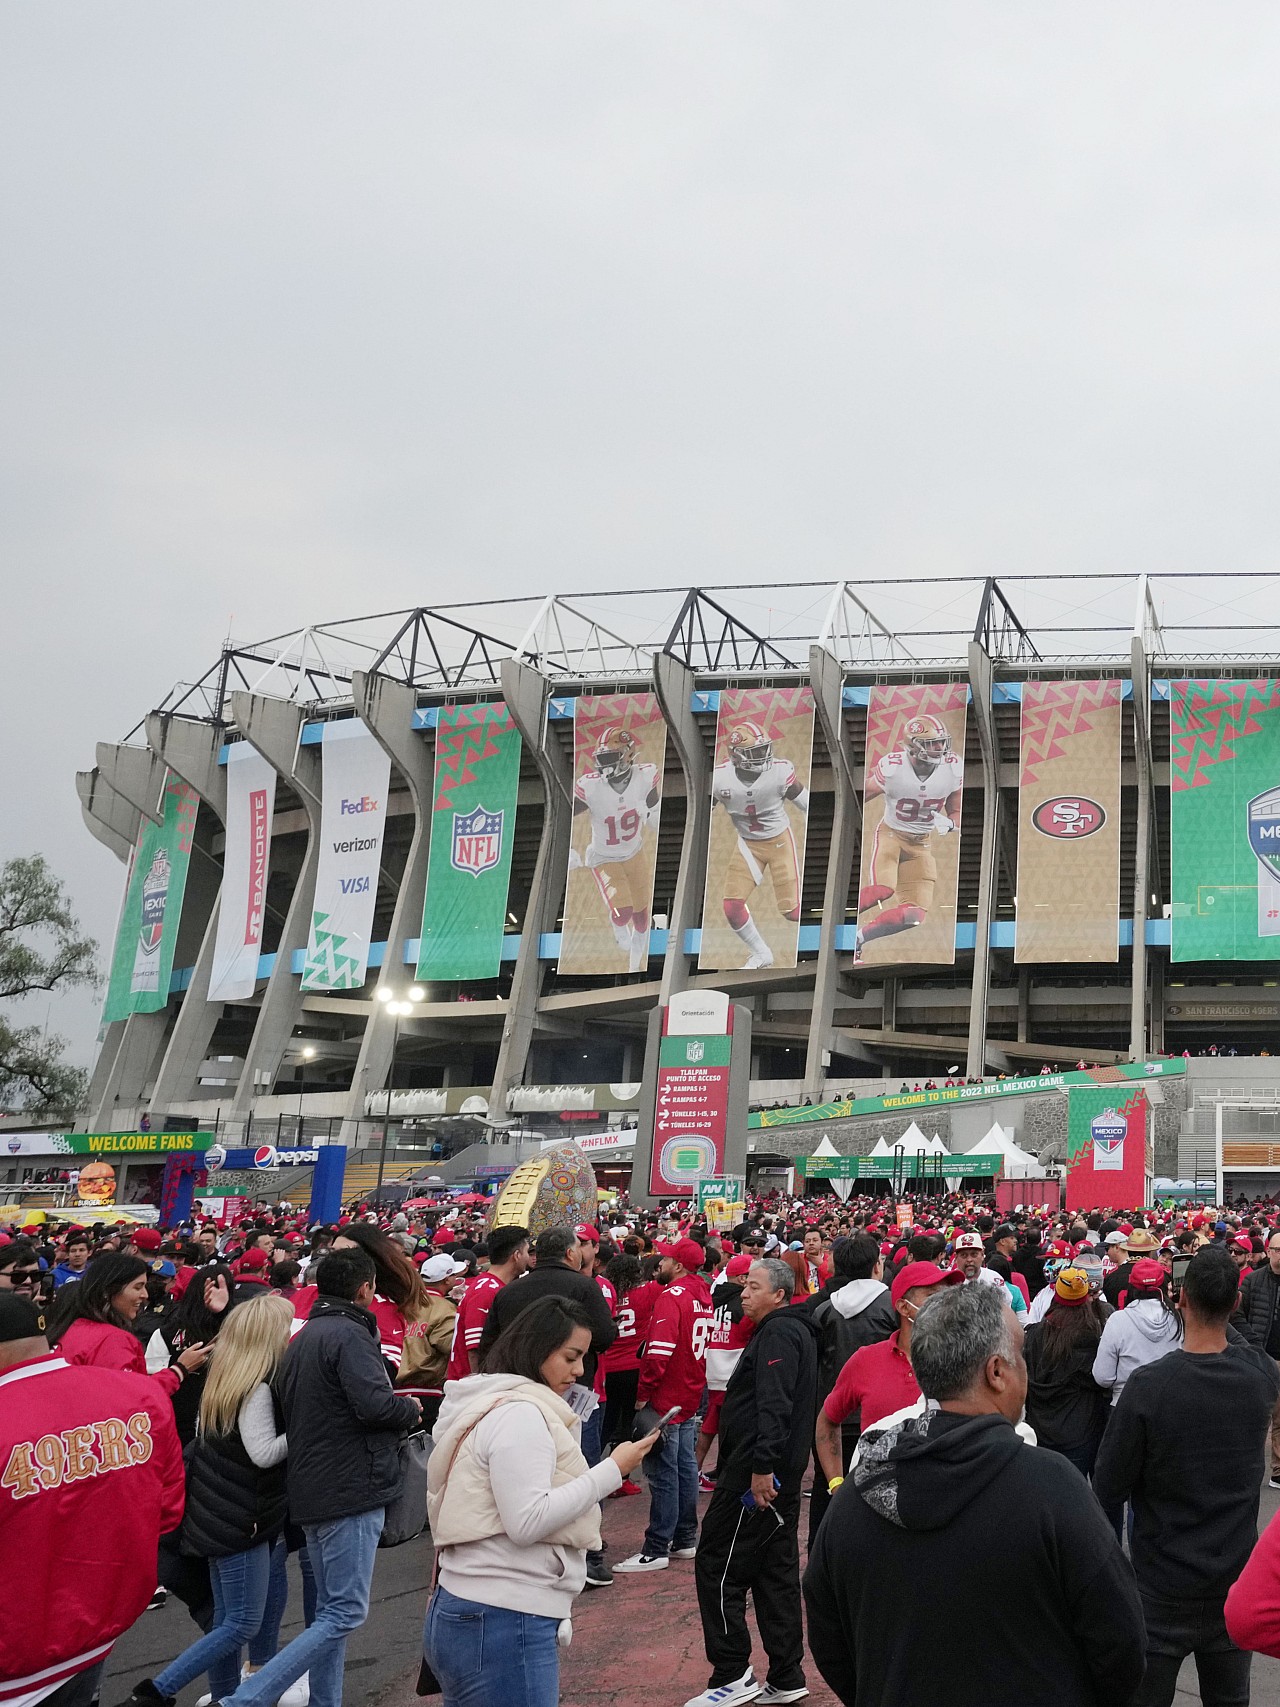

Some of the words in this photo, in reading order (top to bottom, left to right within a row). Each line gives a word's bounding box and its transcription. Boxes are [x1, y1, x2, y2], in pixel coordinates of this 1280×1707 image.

[340, 796, 378, 816] FedEx
[744, 804, 765, 832] 1
[1052, 802, 1093, 835] SF
[604, 808, 640, 846] 19
[254, 794, 265, 907] BANORTE
[333, 838, 378, 854] verizon
[457, 836, 497, 867] NFL
[338, 876, 370, 894] VISA
[1186, 1006, 1203, 1015] SAN
[1205, 1006, 1250, 1015] FRANCISCO
[1252, 1006, 1278, 1015] 49ERS
[883, 1093, 926, 1108] WELCOME
[928, 1092, 939, 1102] TO
[942, 1089, 959, 1100] THE
[960, 1086, 982, 1098] 2022
[984, 1083, 1002, 1094] NFL
[1003, 1080, 1037, 1092] MEXICO
[1039, 1076, 1065, 1087] GAME
[88, 1136, 157, 1151] WELCOME
[160, 1135, 194, 1150] FANS
[273, 1145, 319, 1166] pepsi
[581, 1135, 619, 1148] #NFLMX
[616, 1308, 637, 1338] 2
[1, 1412, 153, 1500] 49ERS
